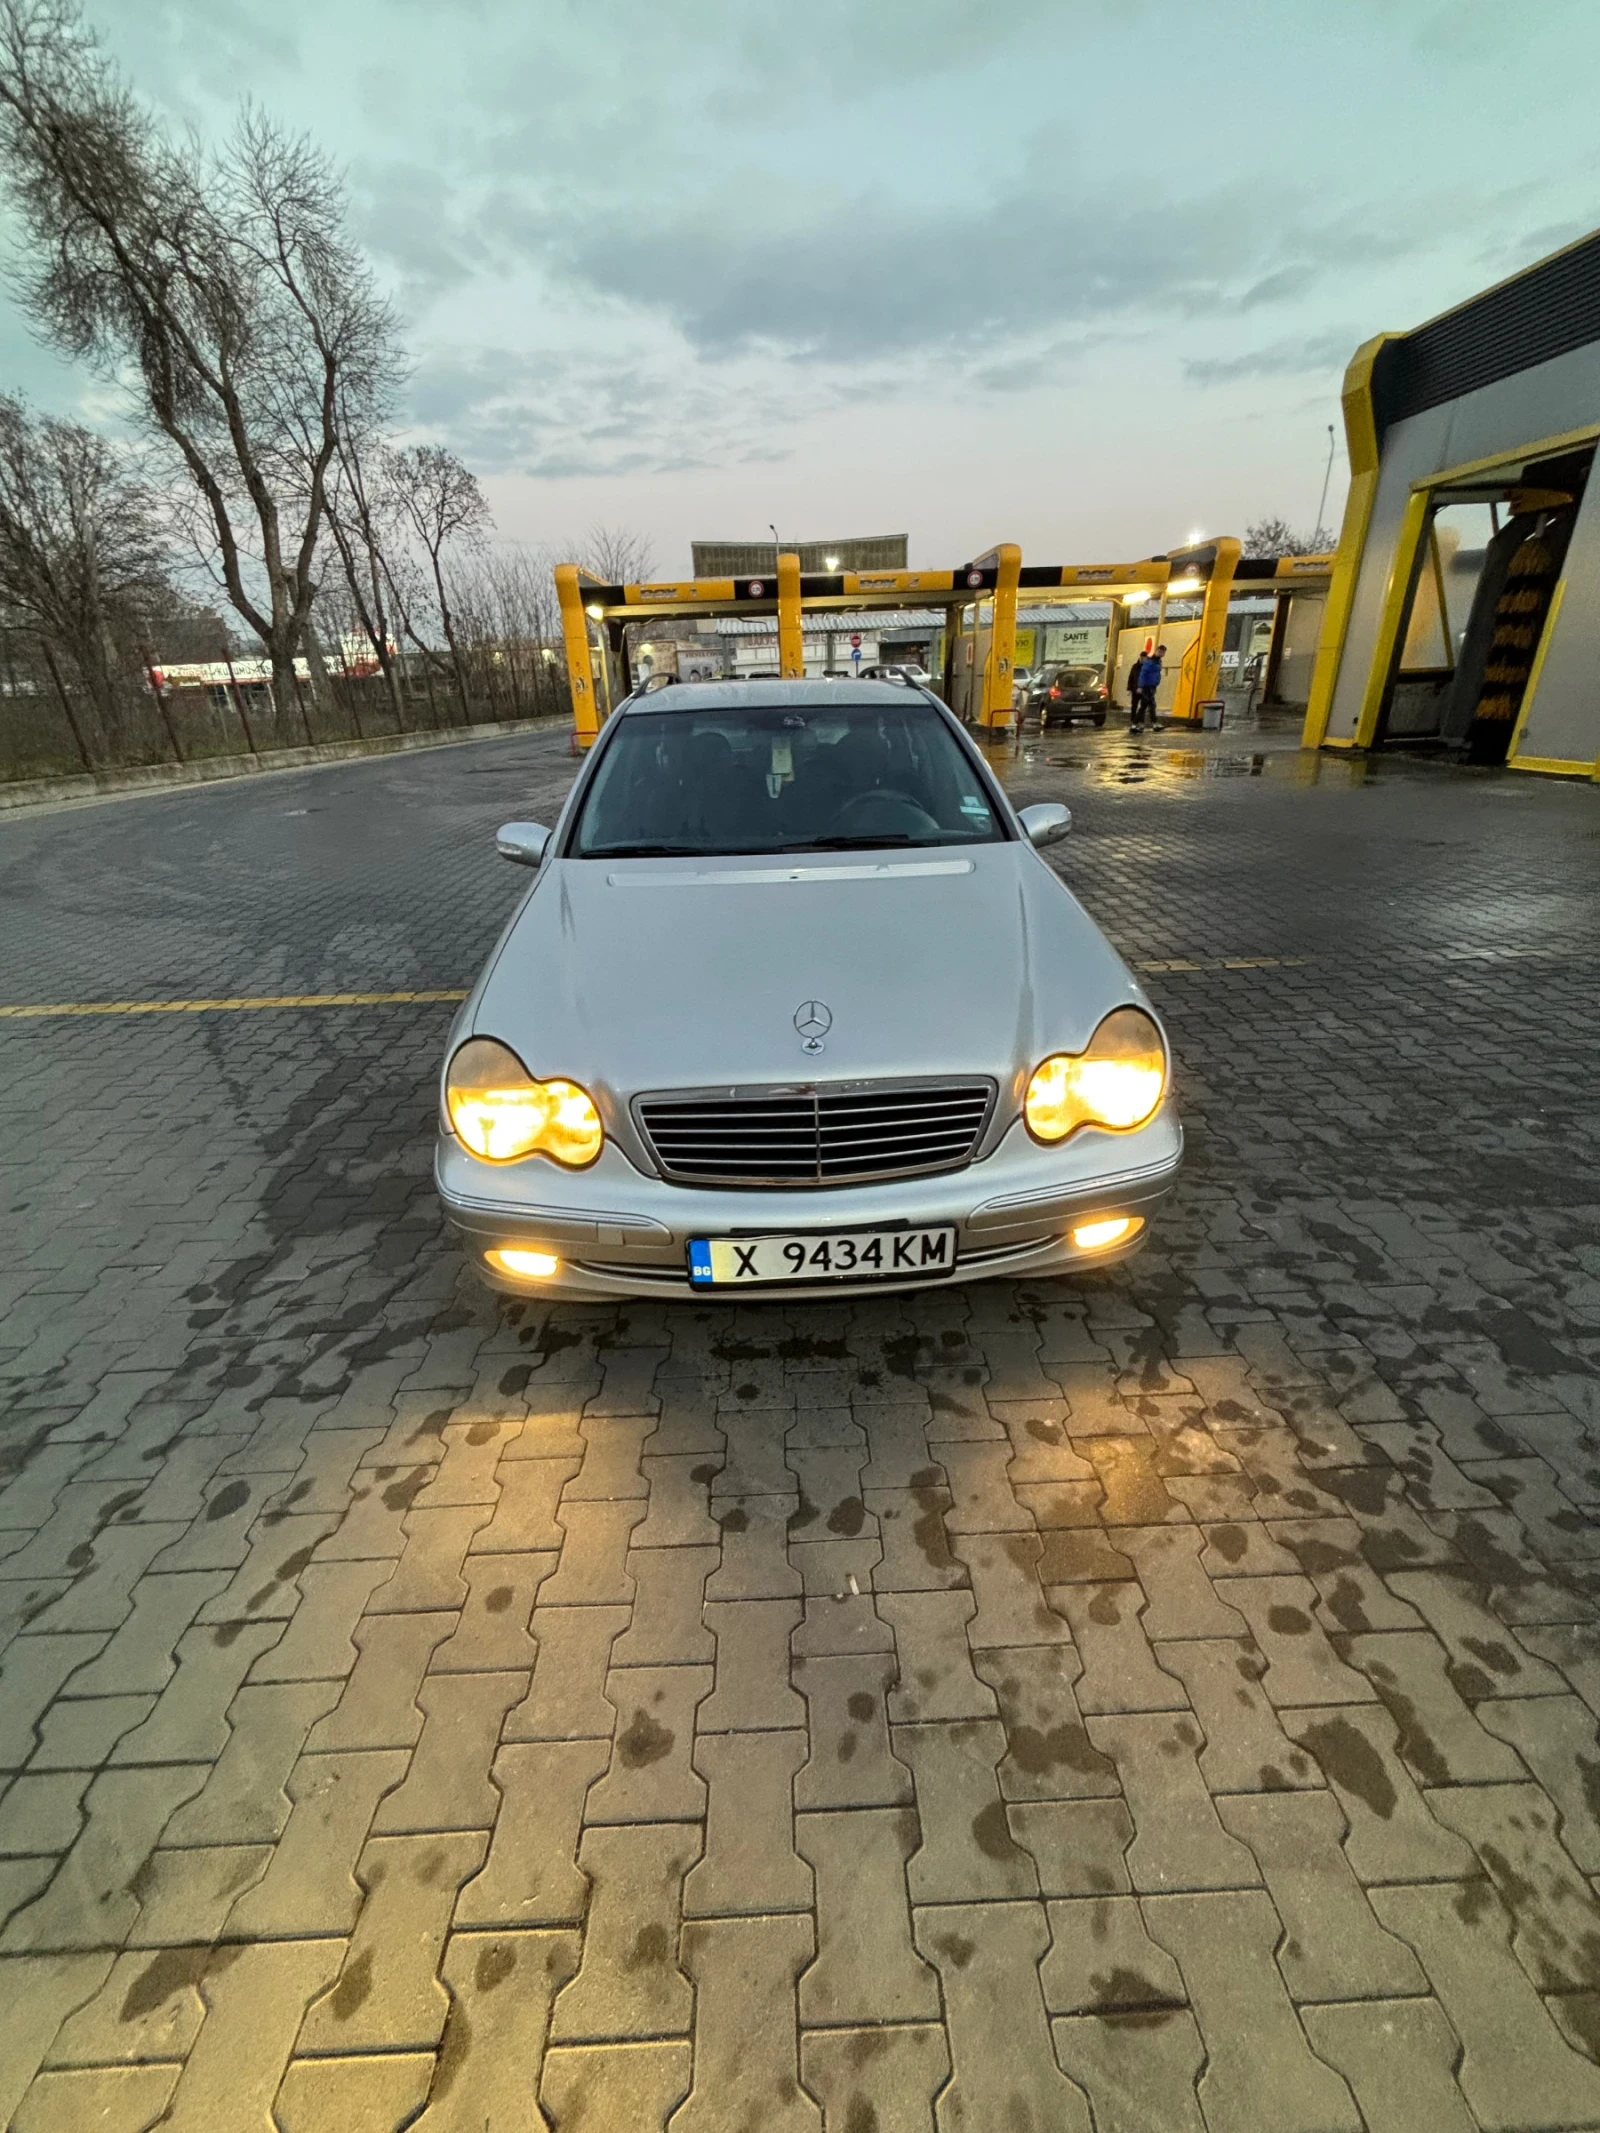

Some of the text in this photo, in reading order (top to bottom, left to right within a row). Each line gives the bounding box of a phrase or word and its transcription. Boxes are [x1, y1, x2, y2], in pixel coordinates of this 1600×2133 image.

[1063, 630, 1089, 642] SANTÉ
[733, 1233, 946, 1277] X 9434 KM
[693, 1266, 711, 1276] BG
